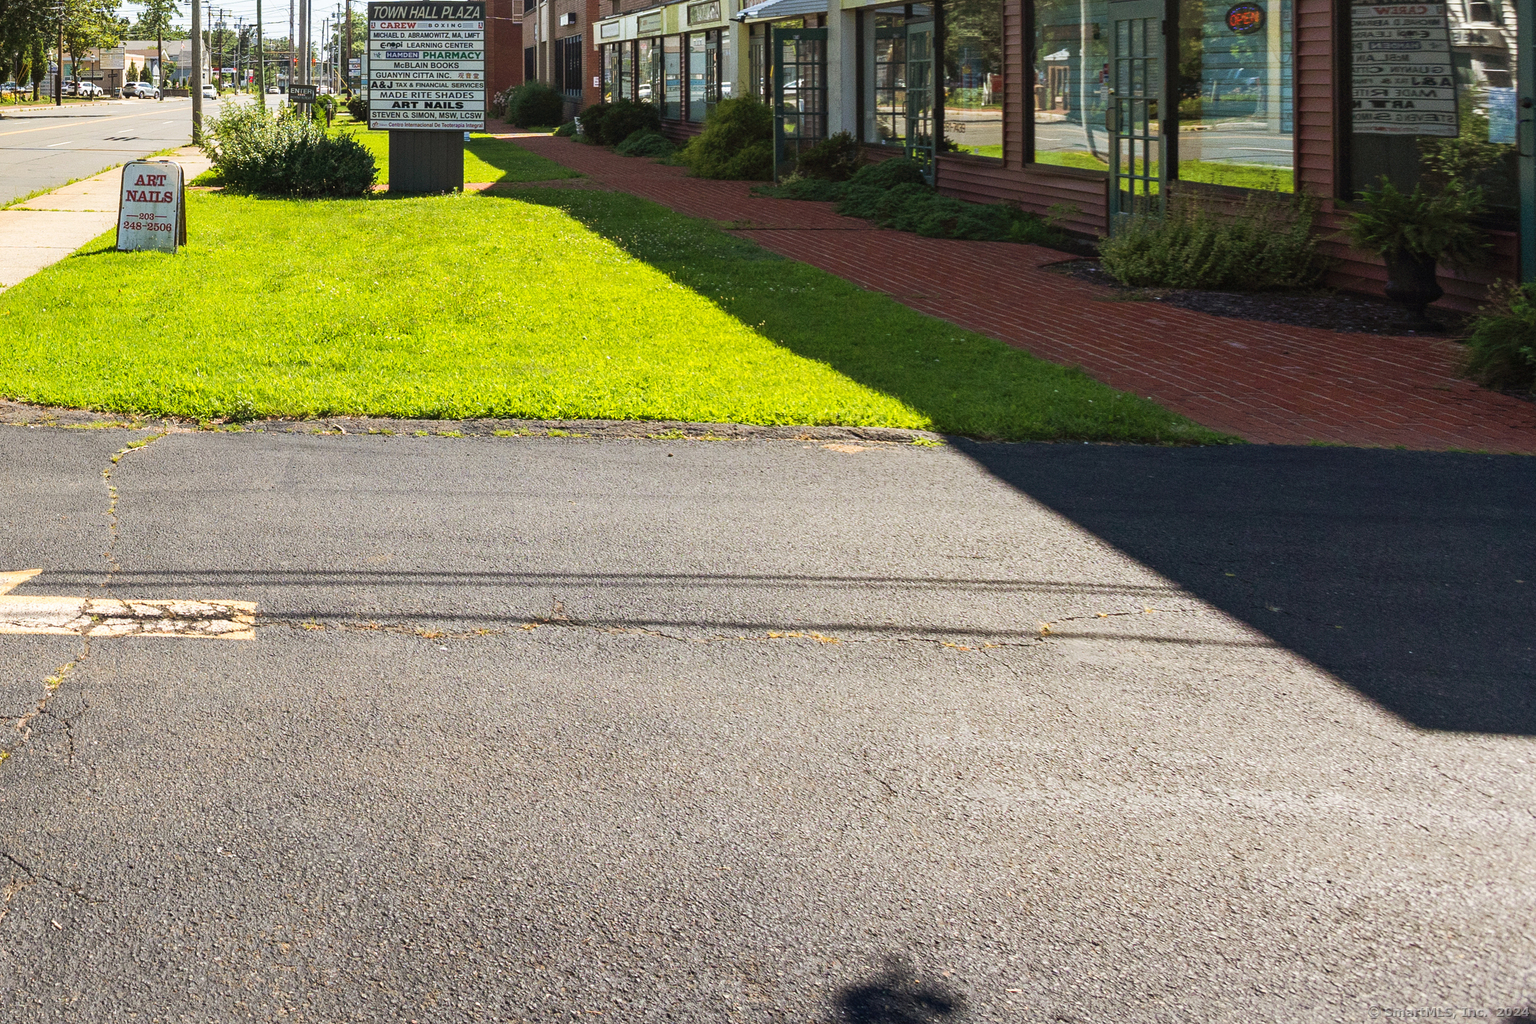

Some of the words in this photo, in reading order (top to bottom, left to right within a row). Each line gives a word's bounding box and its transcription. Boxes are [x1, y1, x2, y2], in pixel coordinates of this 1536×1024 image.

[373, 6, 408, 19] TOWN
[409, 6, 438, 19] HALL
[441, 6, 480, 19] PLAZA
[1230, 11, 1260, 26] OPEN
[134, 174, 167, 186] ART
[125, 190, 173, 203] NAILS
[123, 221, 172, 231] 248-2506
